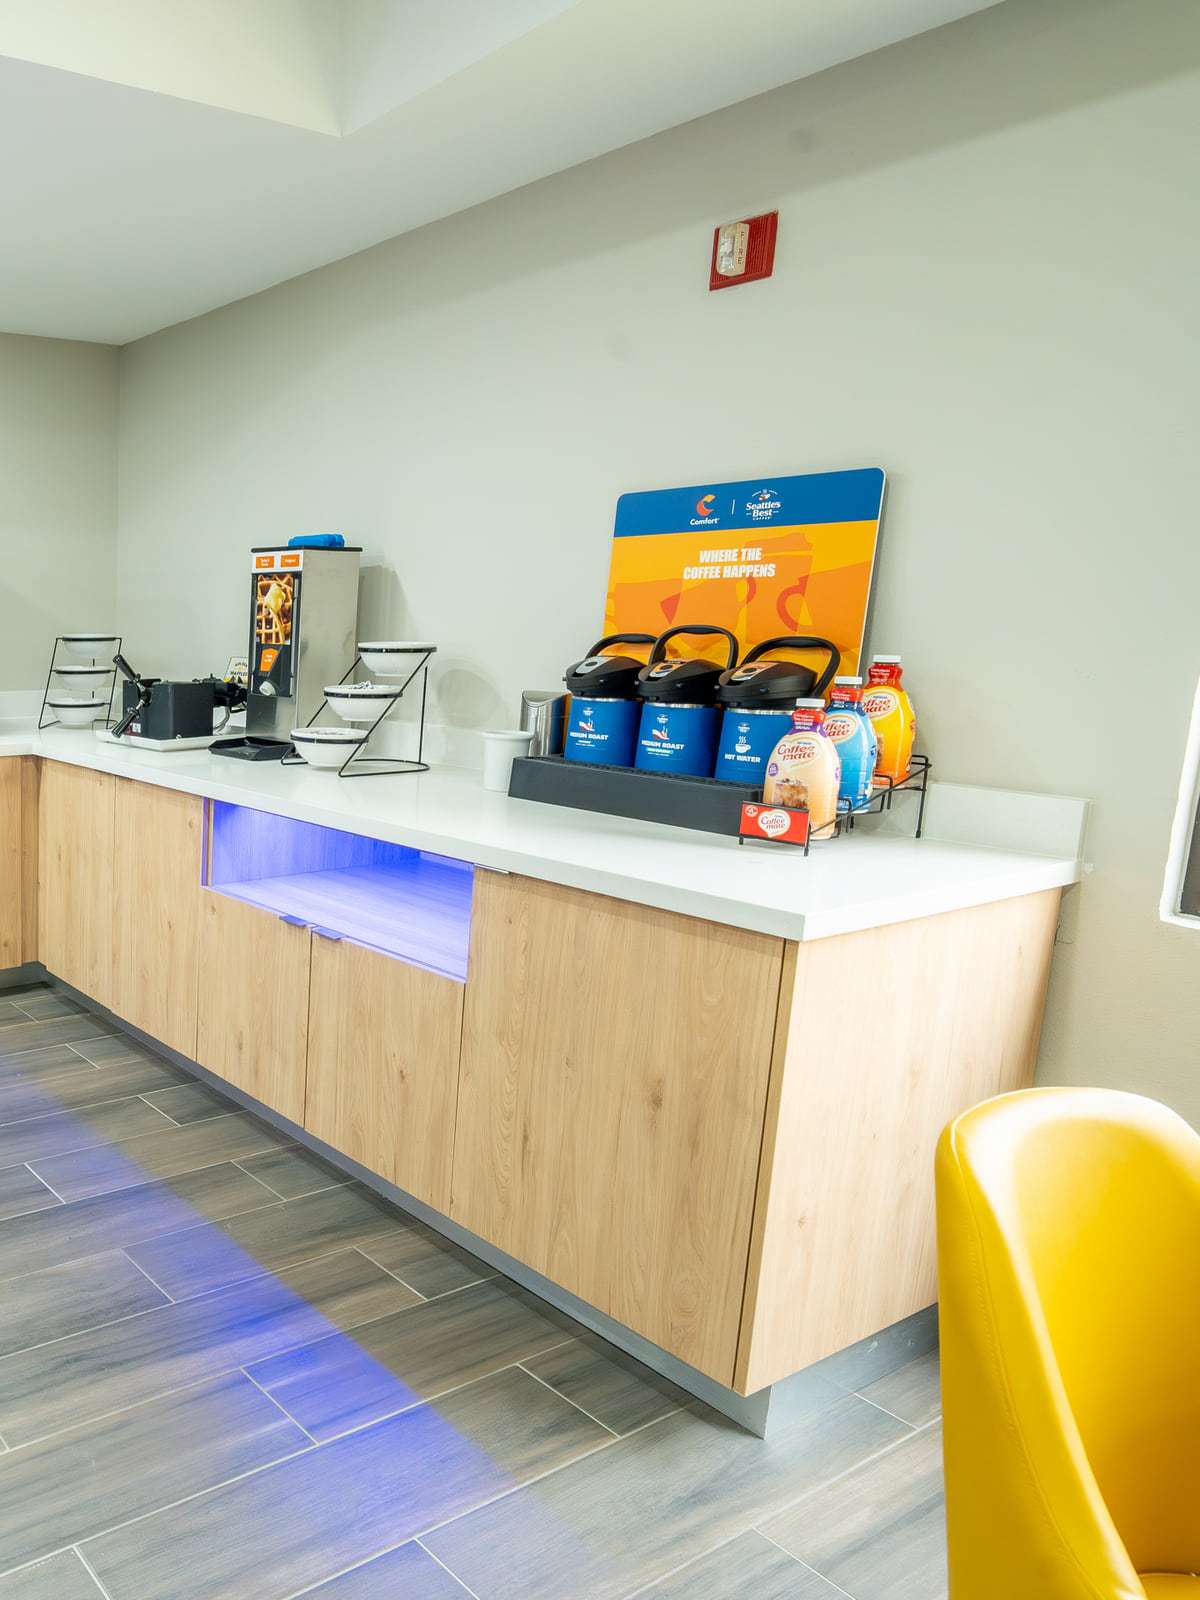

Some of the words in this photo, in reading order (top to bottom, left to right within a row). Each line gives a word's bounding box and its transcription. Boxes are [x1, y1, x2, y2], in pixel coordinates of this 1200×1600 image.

[752, 509, 772, 517] Best
[690, 517, 720, 526] Comfort
[699, 549, 738, 563] WHERE
[741, 547, 762, 561] THE
[683, 566, 721, 580] COFFEE
[722, 564, 776, 578] HAPPENS
[777, 744, 815, 756] Coffee
[736, 754, 761, 763] WATER
[783, 750, 815, 761] mate
[761, 815, 785, 825] Coffee
